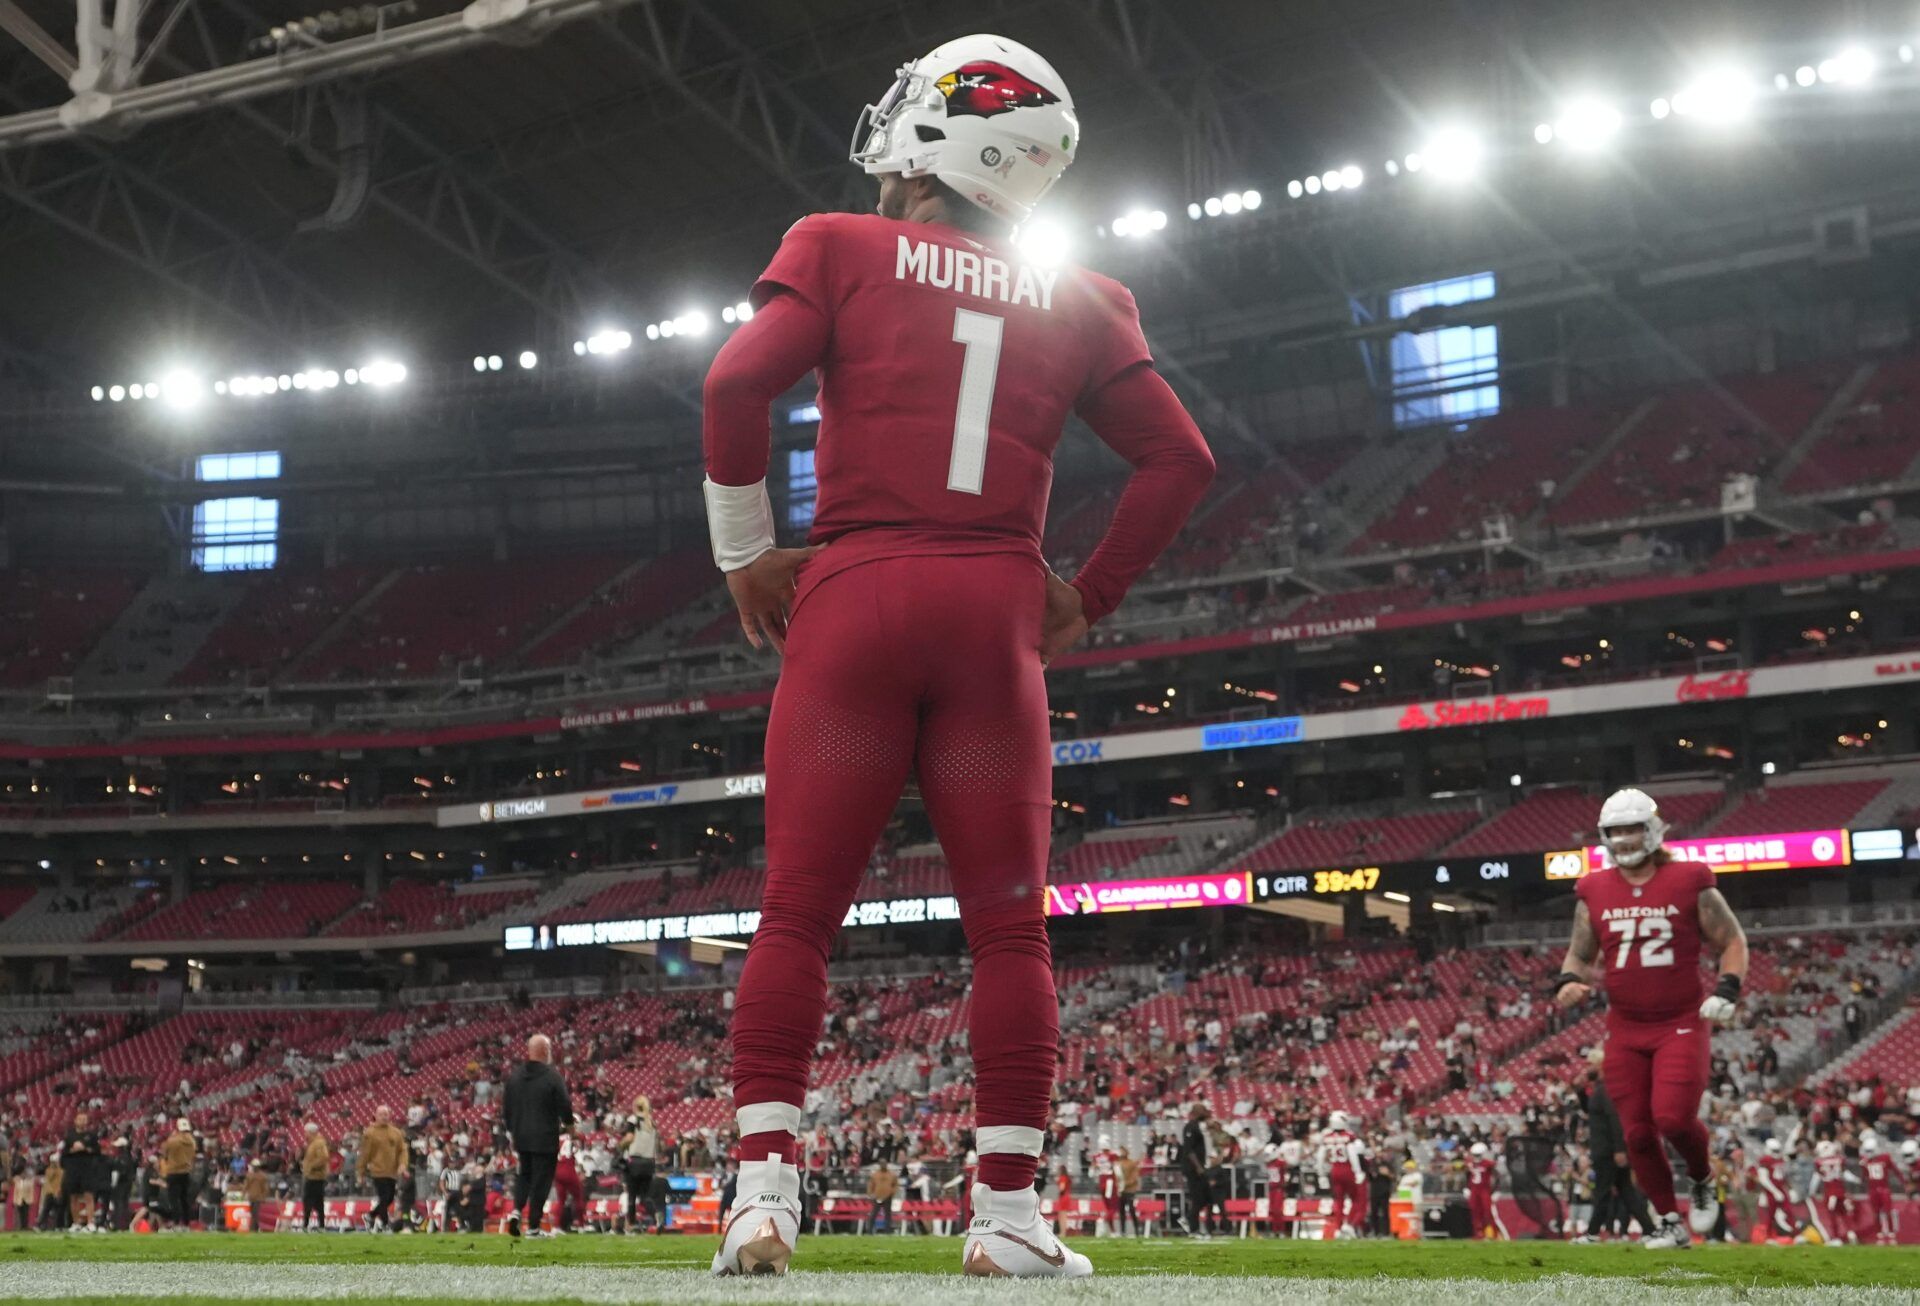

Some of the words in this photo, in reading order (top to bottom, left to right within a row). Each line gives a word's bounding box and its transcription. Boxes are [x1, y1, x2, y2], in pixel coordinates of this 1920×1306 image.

[983, 149, 999, 164] 40
[895, 235, 1059, 311] MURRAY
[946, 307, 1005, 496] 1
[1271, 624, 1301, 642] PAT
[1305, 616, 1376, 636] TILLMAN
[560, 712, 613, 730] CHARLES
[1434, 698, 1491, 727] State
[1493, 693, 1549, 721] Farm
[1055, 740, 1103, 765] COX
[494, 799, 546, 818] BETMGM
[1671, 838, 1786, 865] ALCONS
[1435, 865, 1450, 883] &
[1479, 861, 1510, 880] ON
[1548, 853, 1581, 877] 40
[1097, 883, 1200, 904] CARDINALS
[1256, 877, 1269, 897] 1
[1272, 875, 1308, 894] QTR
[1313, 867, 1381, 894] 39:47
[1601, 904, 1680, 921] ARIZONA
[1608, 918, 1675, 969] 72
[759, 1194, 782, 1203] NIKE
[972, 1219, 993, 1228] NIKE
